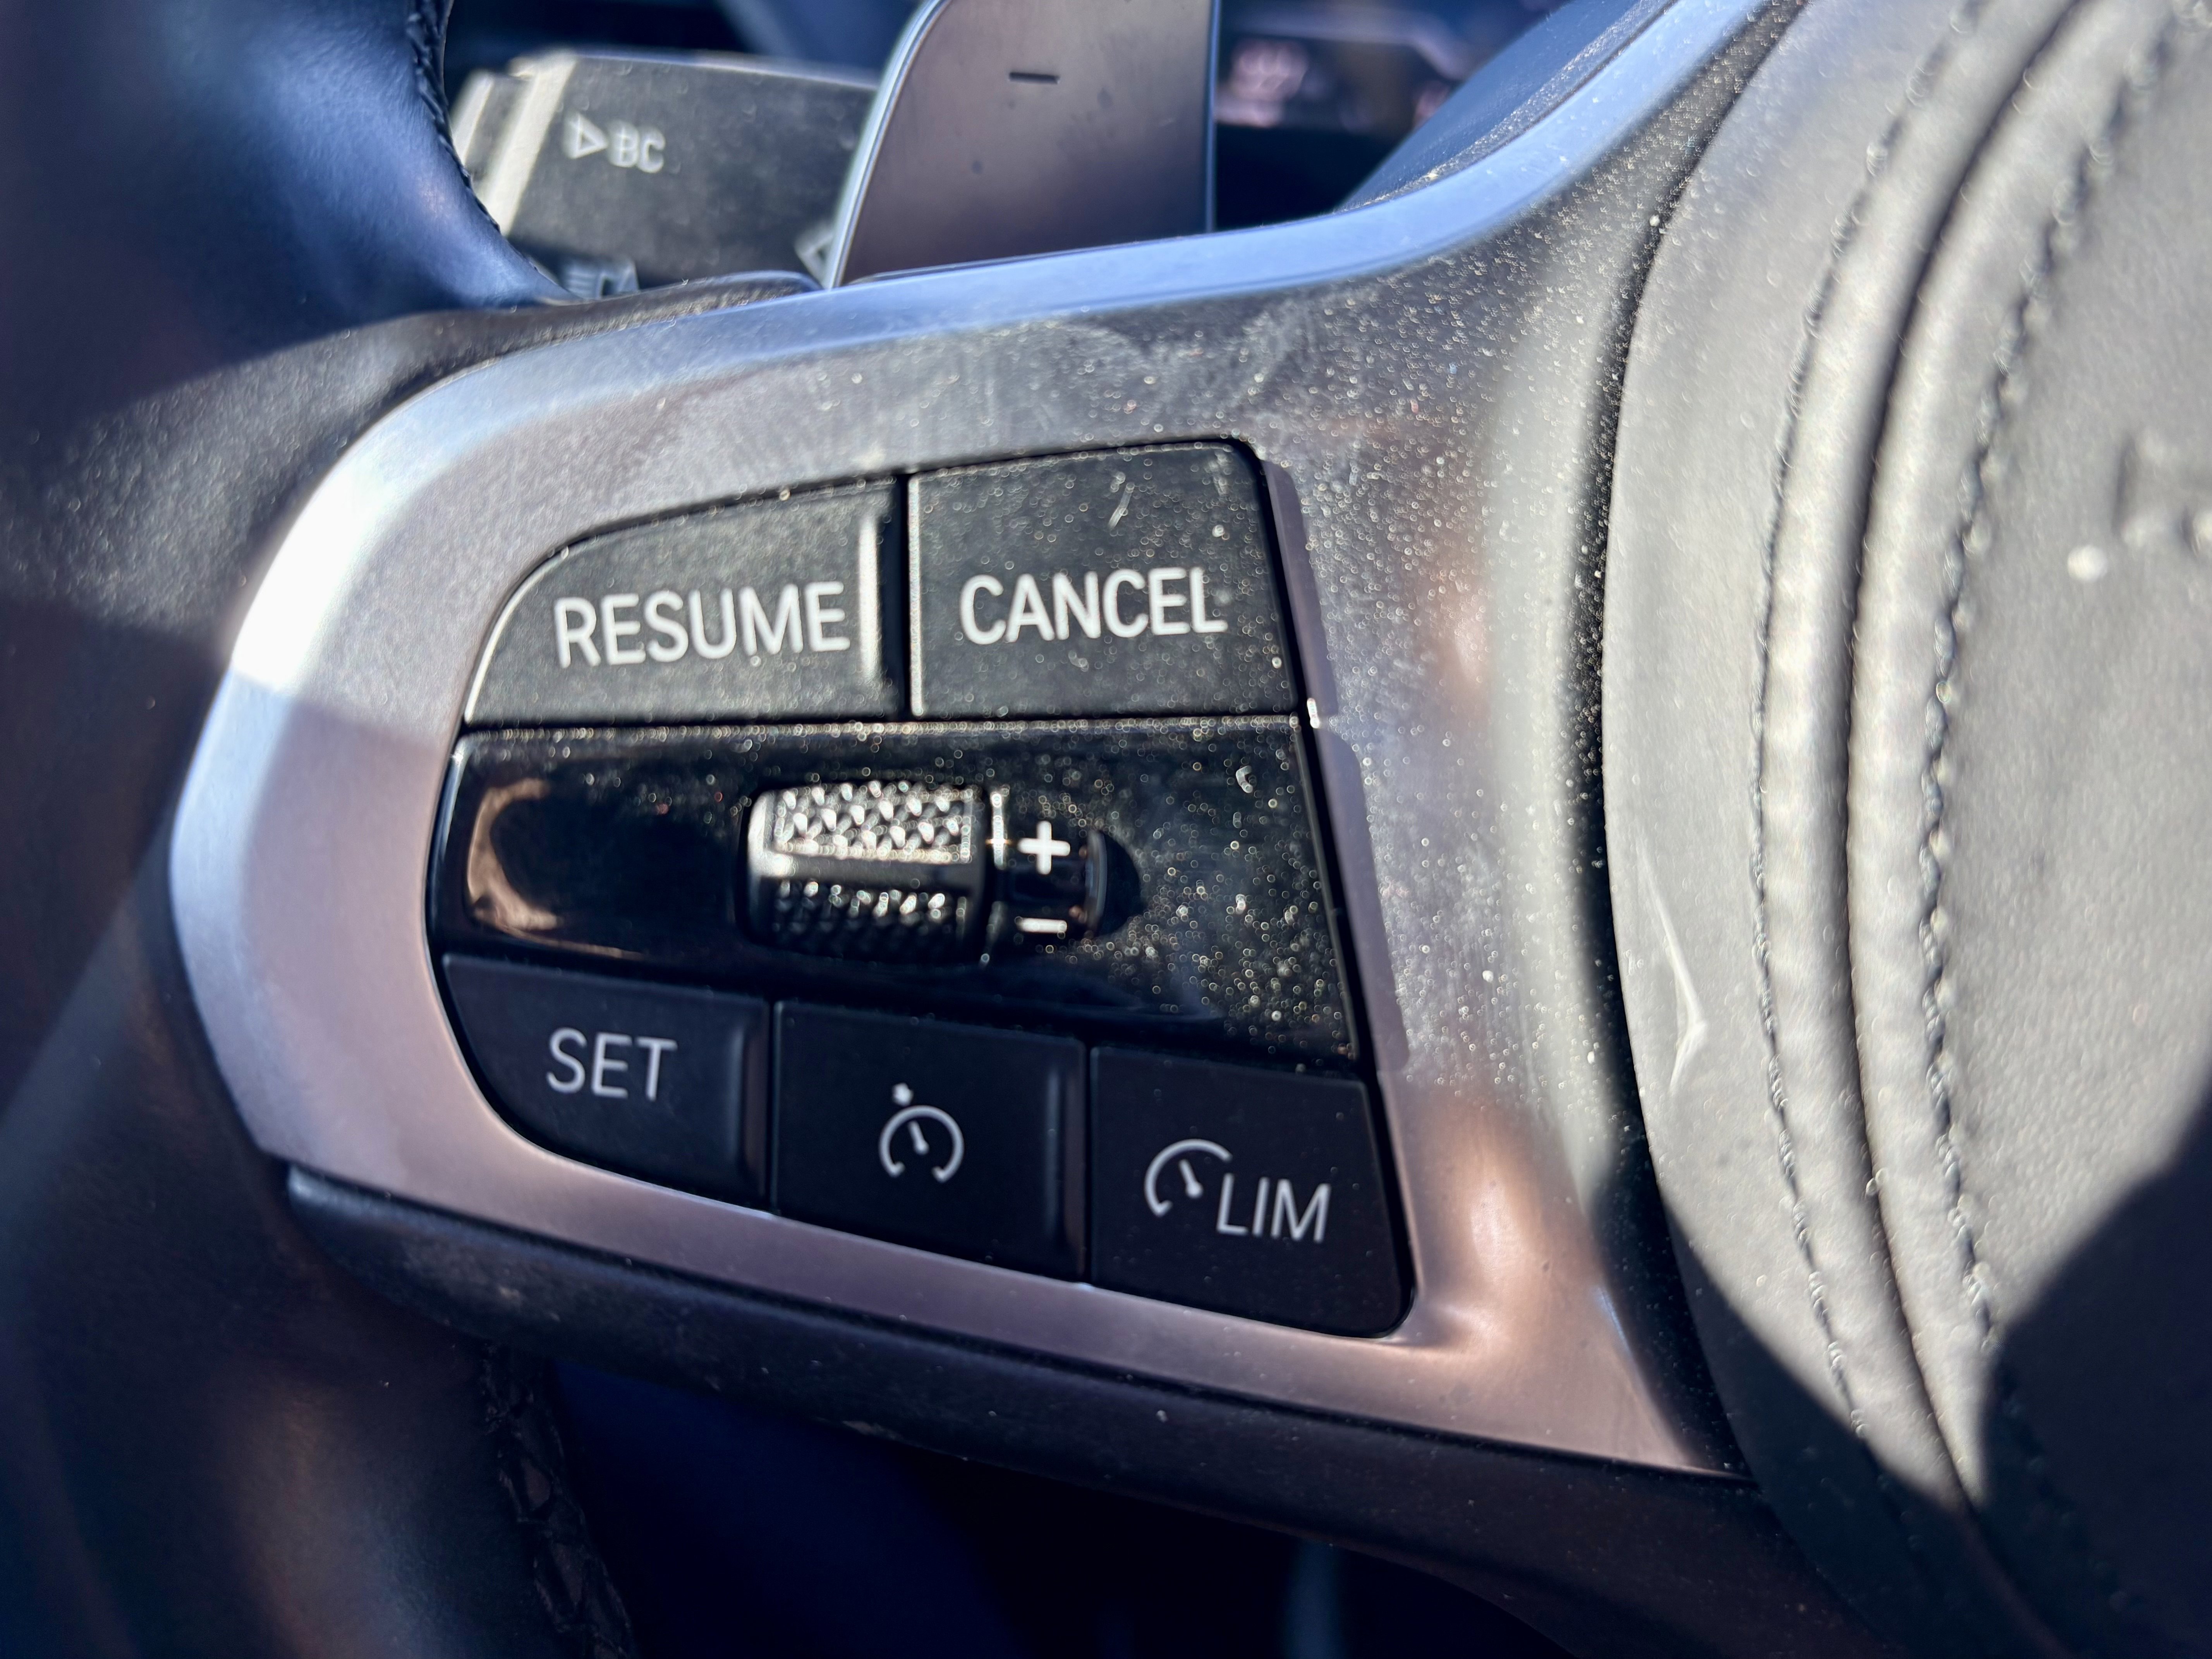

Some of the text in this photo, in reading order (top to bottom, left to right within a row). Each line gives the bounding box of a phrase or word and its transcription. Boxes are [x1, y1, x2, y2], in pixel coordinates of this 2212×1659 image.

[607, 121, 665, 173] BC
[555, 582, 850, 668] RESUME
[960, 567, 1228, 646] CANCEL
[546, 1028, 678, 1100] SET
[1217, 1173, 1331, 1242] LIM
